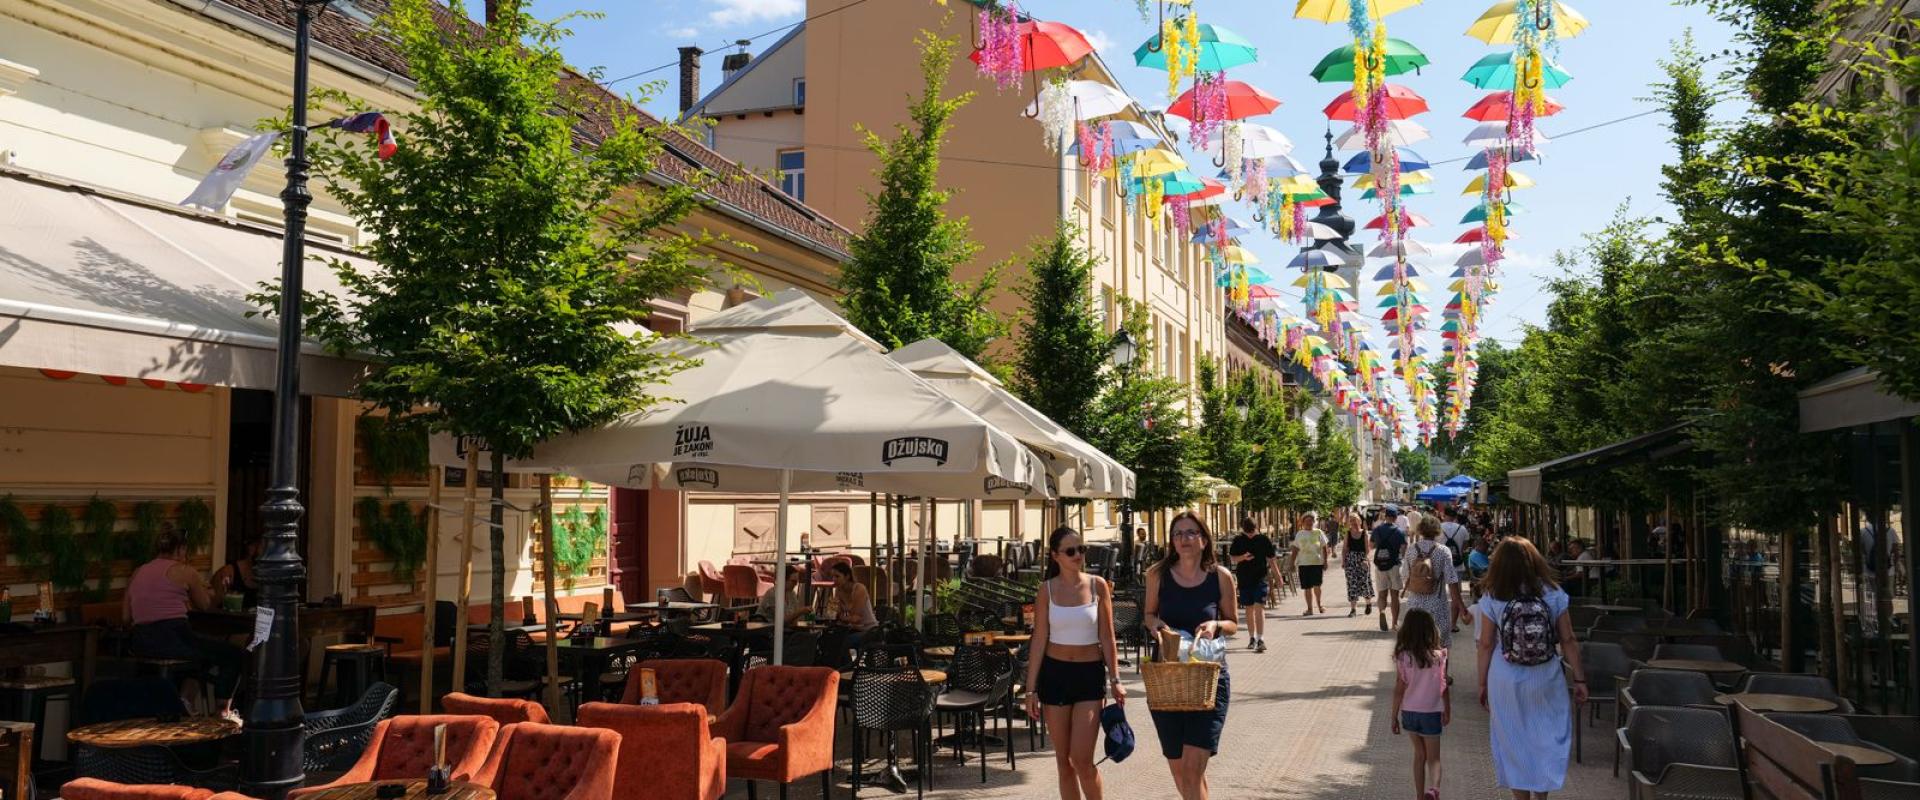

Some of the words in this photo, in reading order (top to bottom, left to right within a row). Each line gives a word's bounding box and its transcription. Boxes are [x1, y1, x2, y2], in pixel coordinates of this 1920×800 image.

[675, 424, 711, 446] ŽUJA
[672, 445, 682, 457] JE
[683, 441, 713, 453] ZAKON!
[887, 438, 943, 459] Ožujsko
